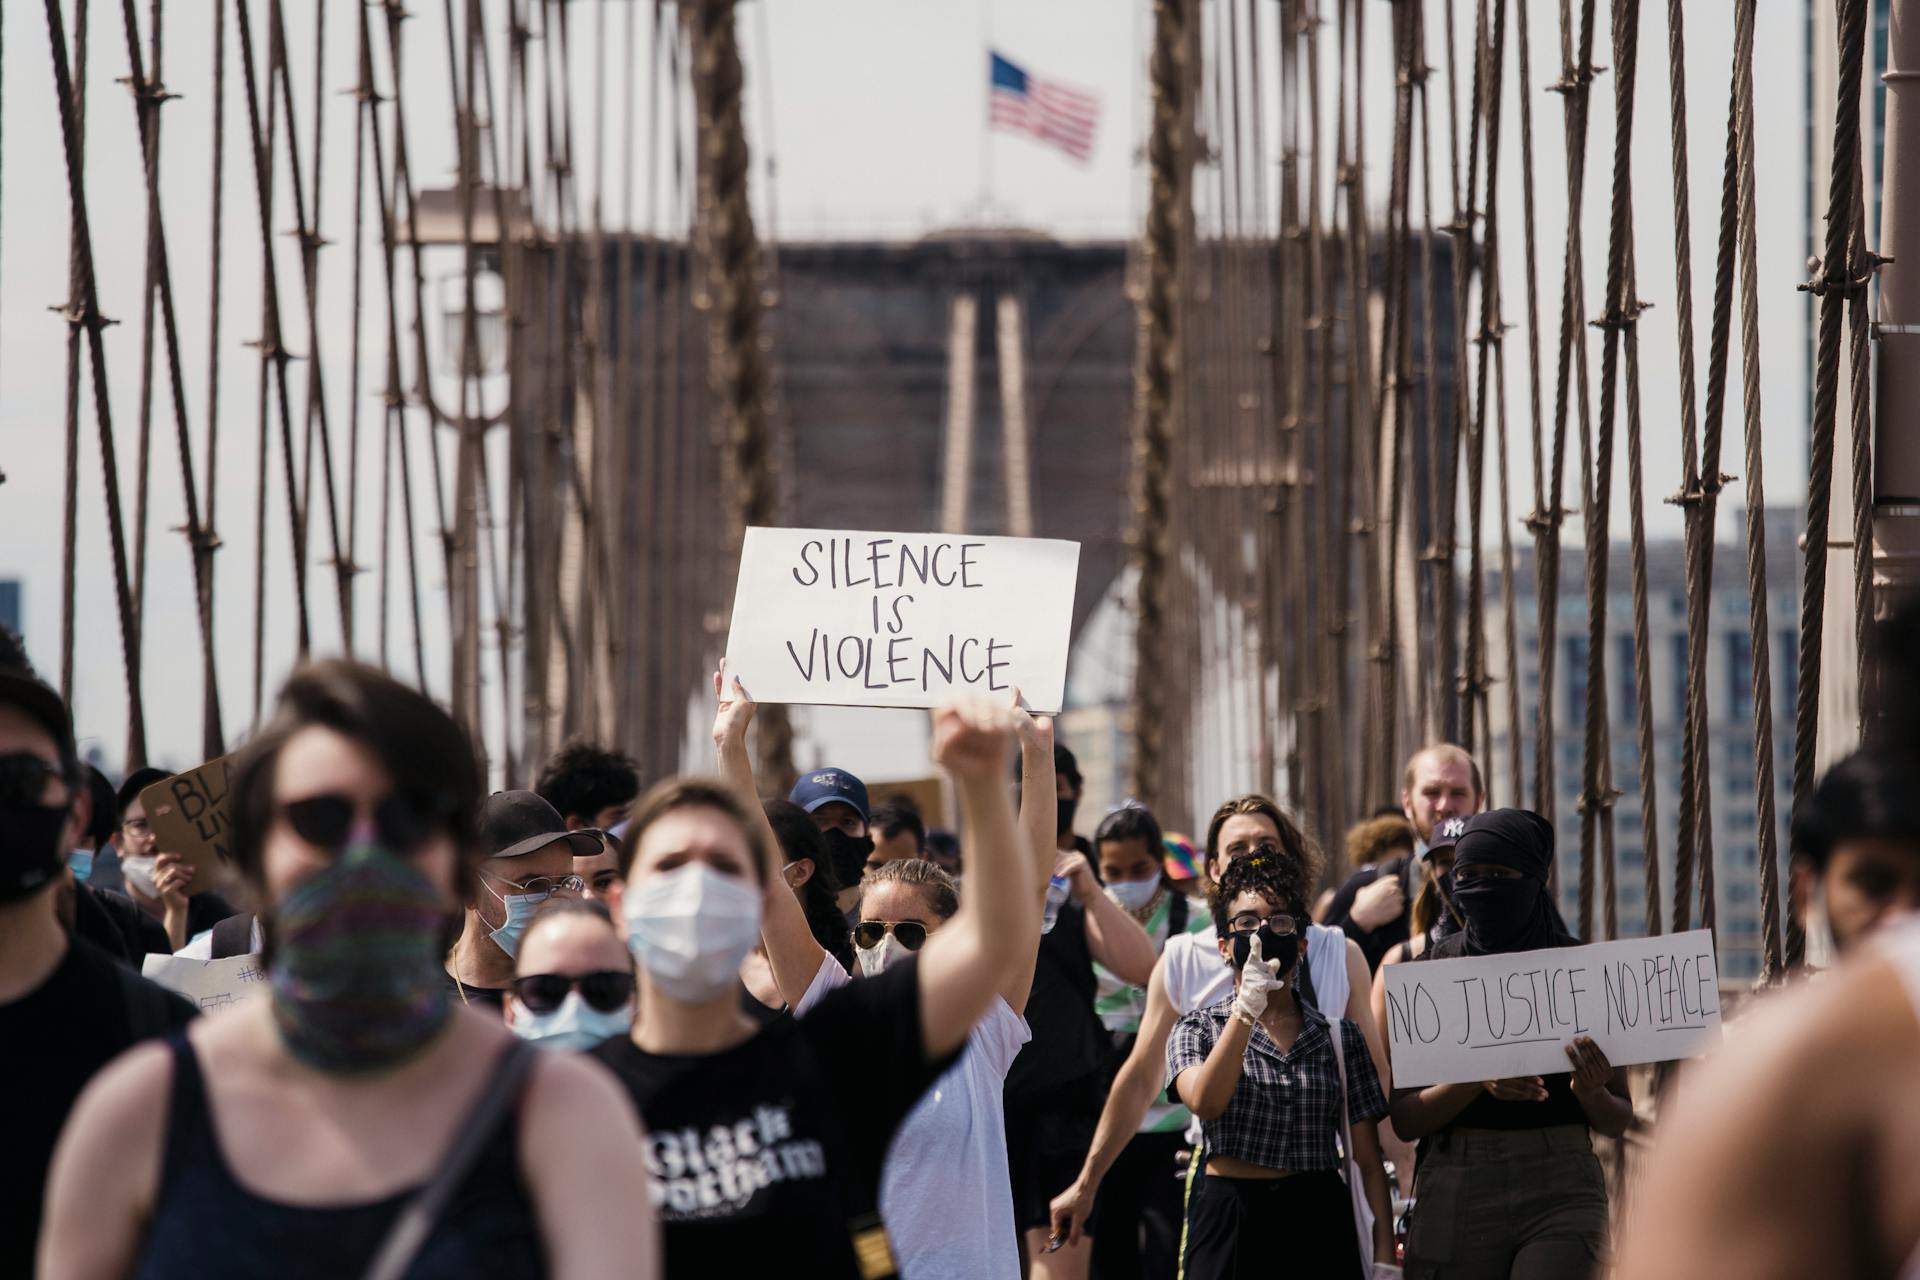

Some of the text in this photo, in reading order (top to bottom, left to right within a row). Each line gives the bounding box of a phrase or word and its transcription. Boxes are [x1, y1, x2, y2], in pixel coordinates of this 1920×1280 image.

[792, 538, 986, 589] SILENCE
[872, 594, 914, 634] IS
[786, 628, 1013, 692] VIOLENCE
[1386, 953, 1717, 1047] NO JUSTICE NO PEACE
